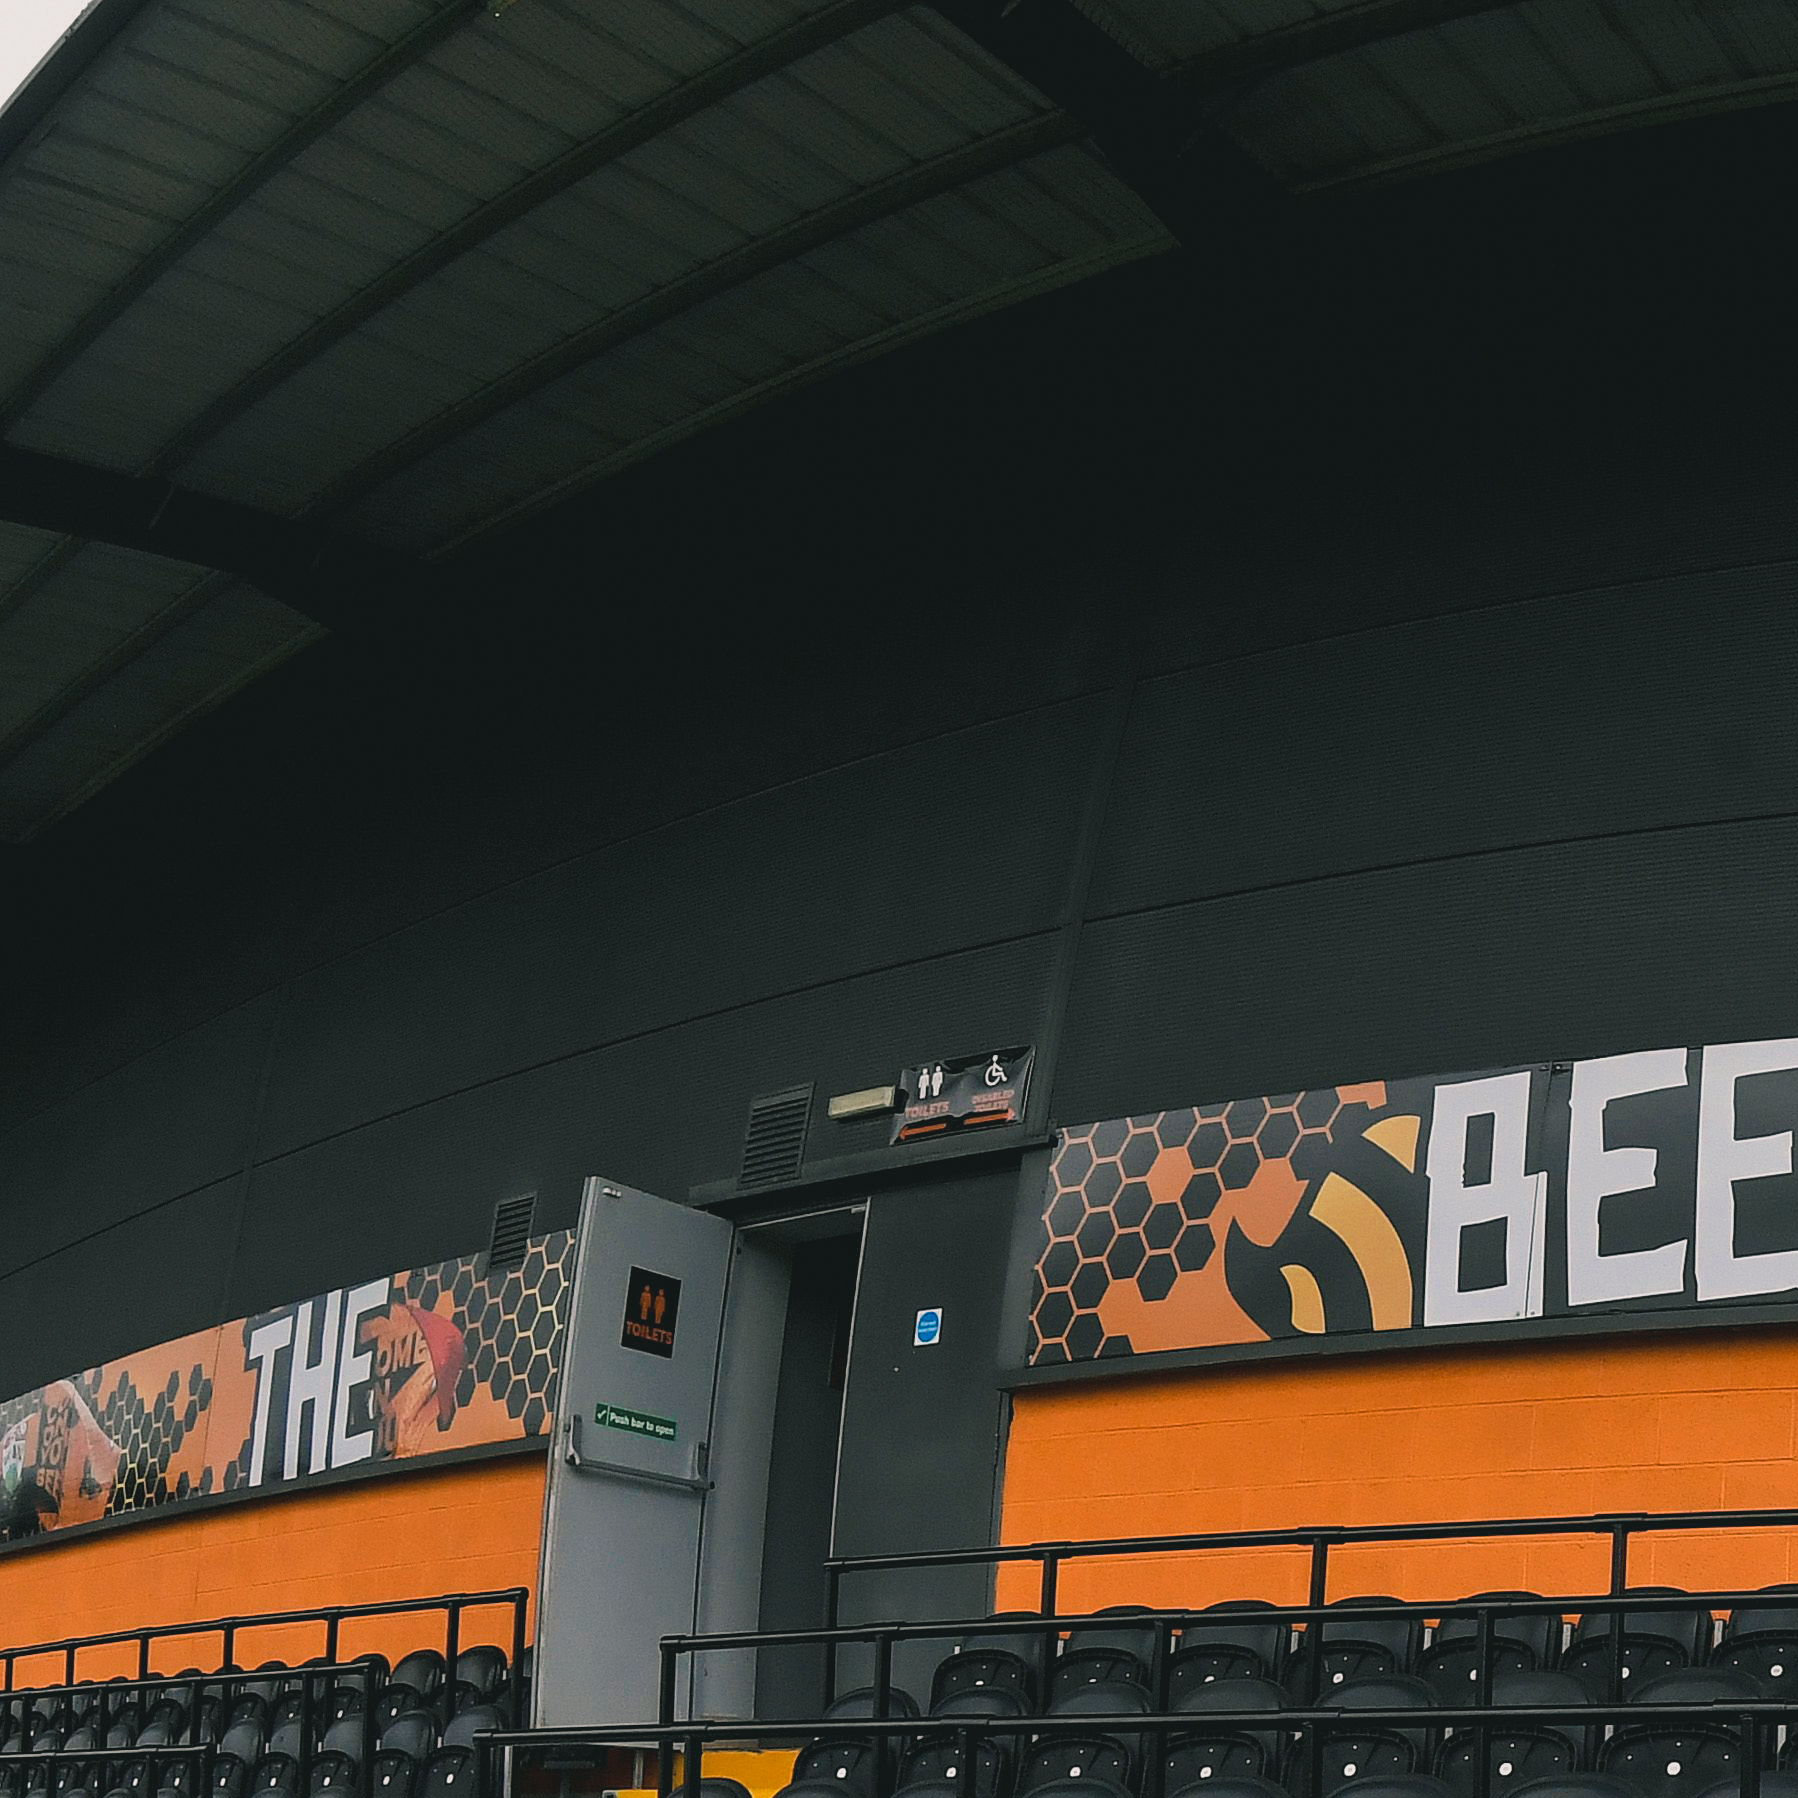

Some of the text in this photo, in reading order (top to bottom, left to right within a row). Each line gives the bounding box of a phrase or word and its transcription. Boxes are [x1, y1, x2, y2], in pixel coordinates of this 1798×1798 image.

[905, 1101, 950, 1118] TOILETS
[626, 1320, 673, 1345] TOILETS
[249, 1277, 390, 1487] THE
[609, 1411, 675, 1437] Push bar to open
